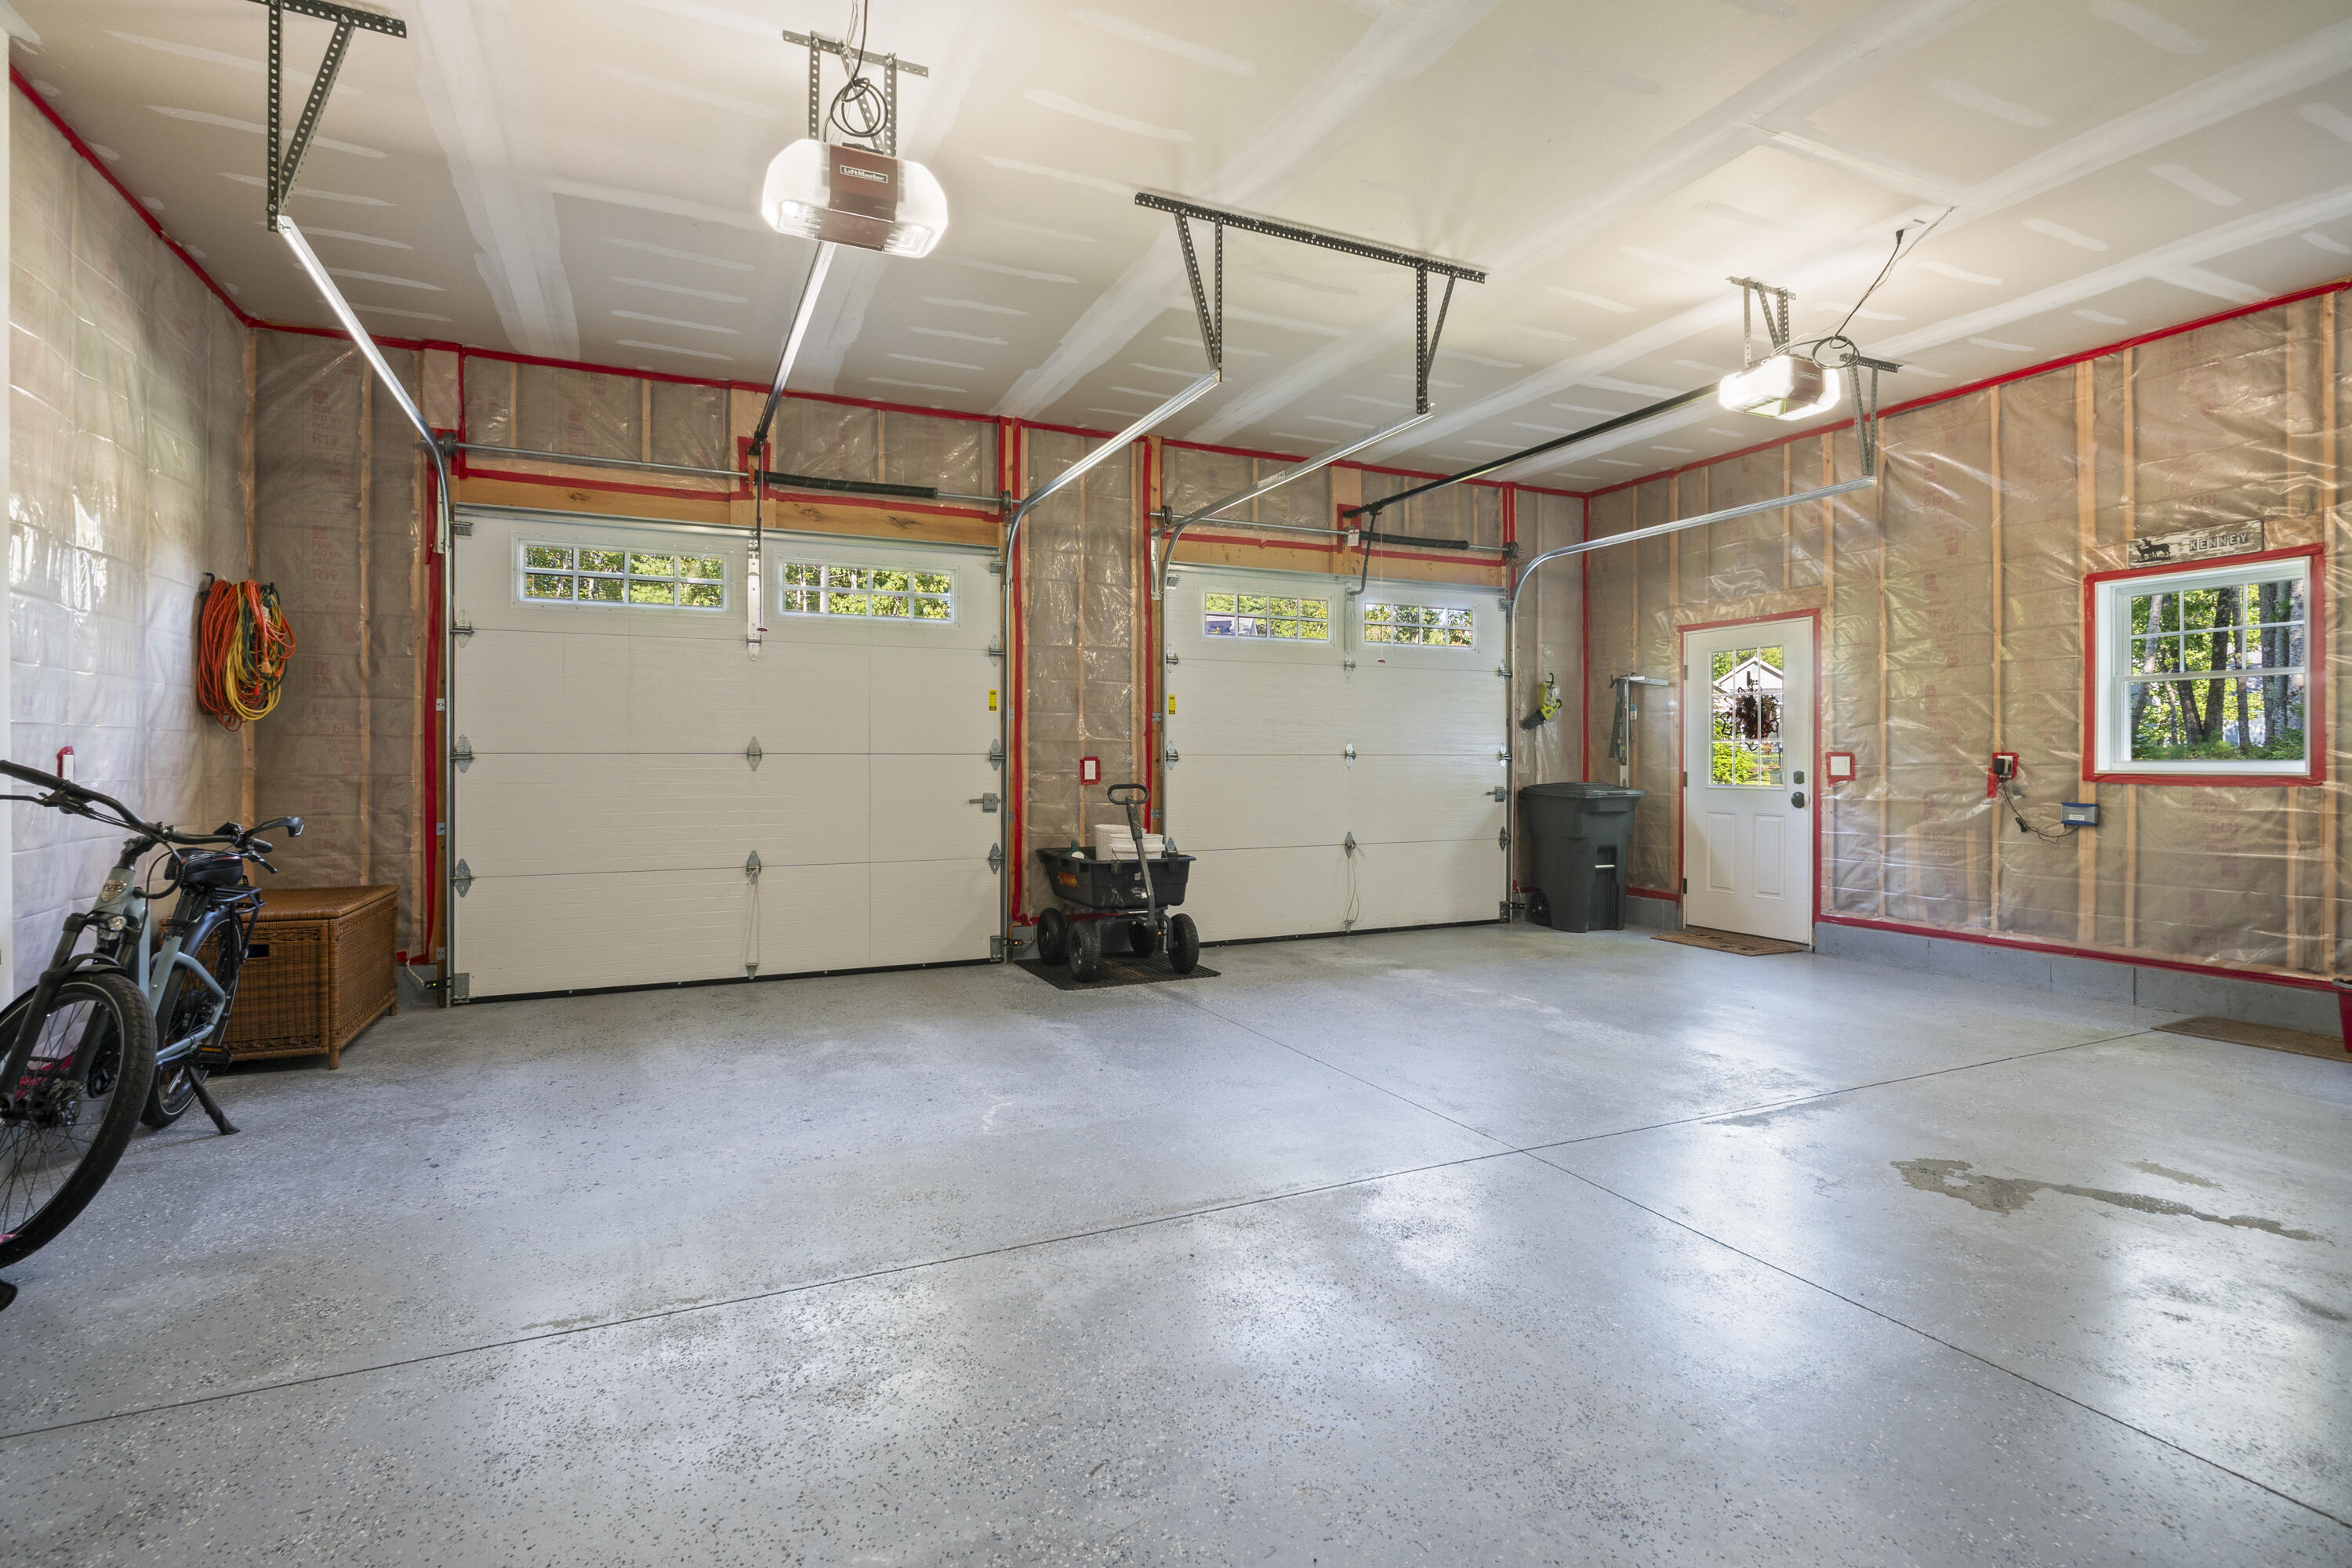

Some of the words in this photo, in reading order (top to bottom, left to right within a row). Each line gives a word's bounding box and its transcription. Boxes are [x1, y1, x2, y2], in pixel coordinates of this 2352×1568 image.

[843, 166, 885, 181] LiftMaster
[312, 432, 339, 445] R19
[2189, 533, 2249, 551] KENNEY
[312, 568, 339, 581] R19
